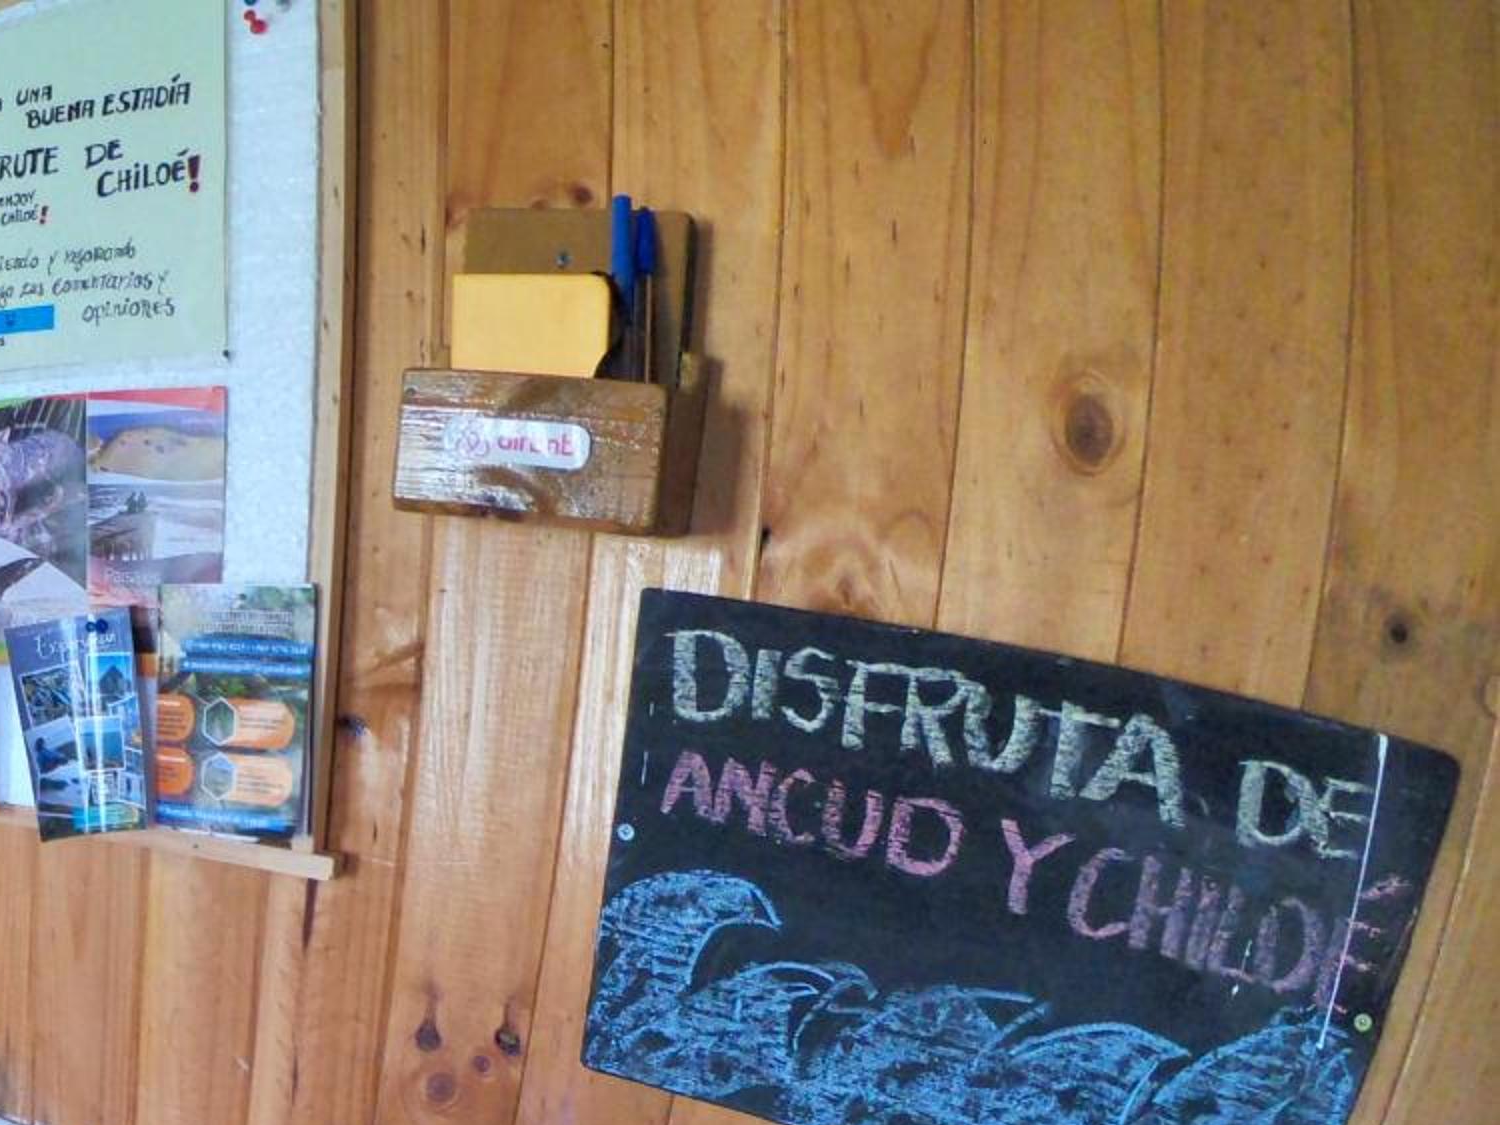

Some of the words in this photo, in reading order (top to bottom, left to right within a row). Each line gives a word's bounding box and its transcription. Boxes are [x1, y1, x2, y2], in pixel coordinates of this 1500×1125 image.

[15, 84, 53, 107] UNA
[26, 97, 95, 130] BUENA
[100, 73, 192, 117] ESTADÍA
[84, 139, 124, 170] DE
[664, 627, 1185, 829] DISFRUTA
[1236, 757, 1374, 862] DE
[659, 748, 964, 878] ANCUD
[1000, 816, 1078, 916] Y
